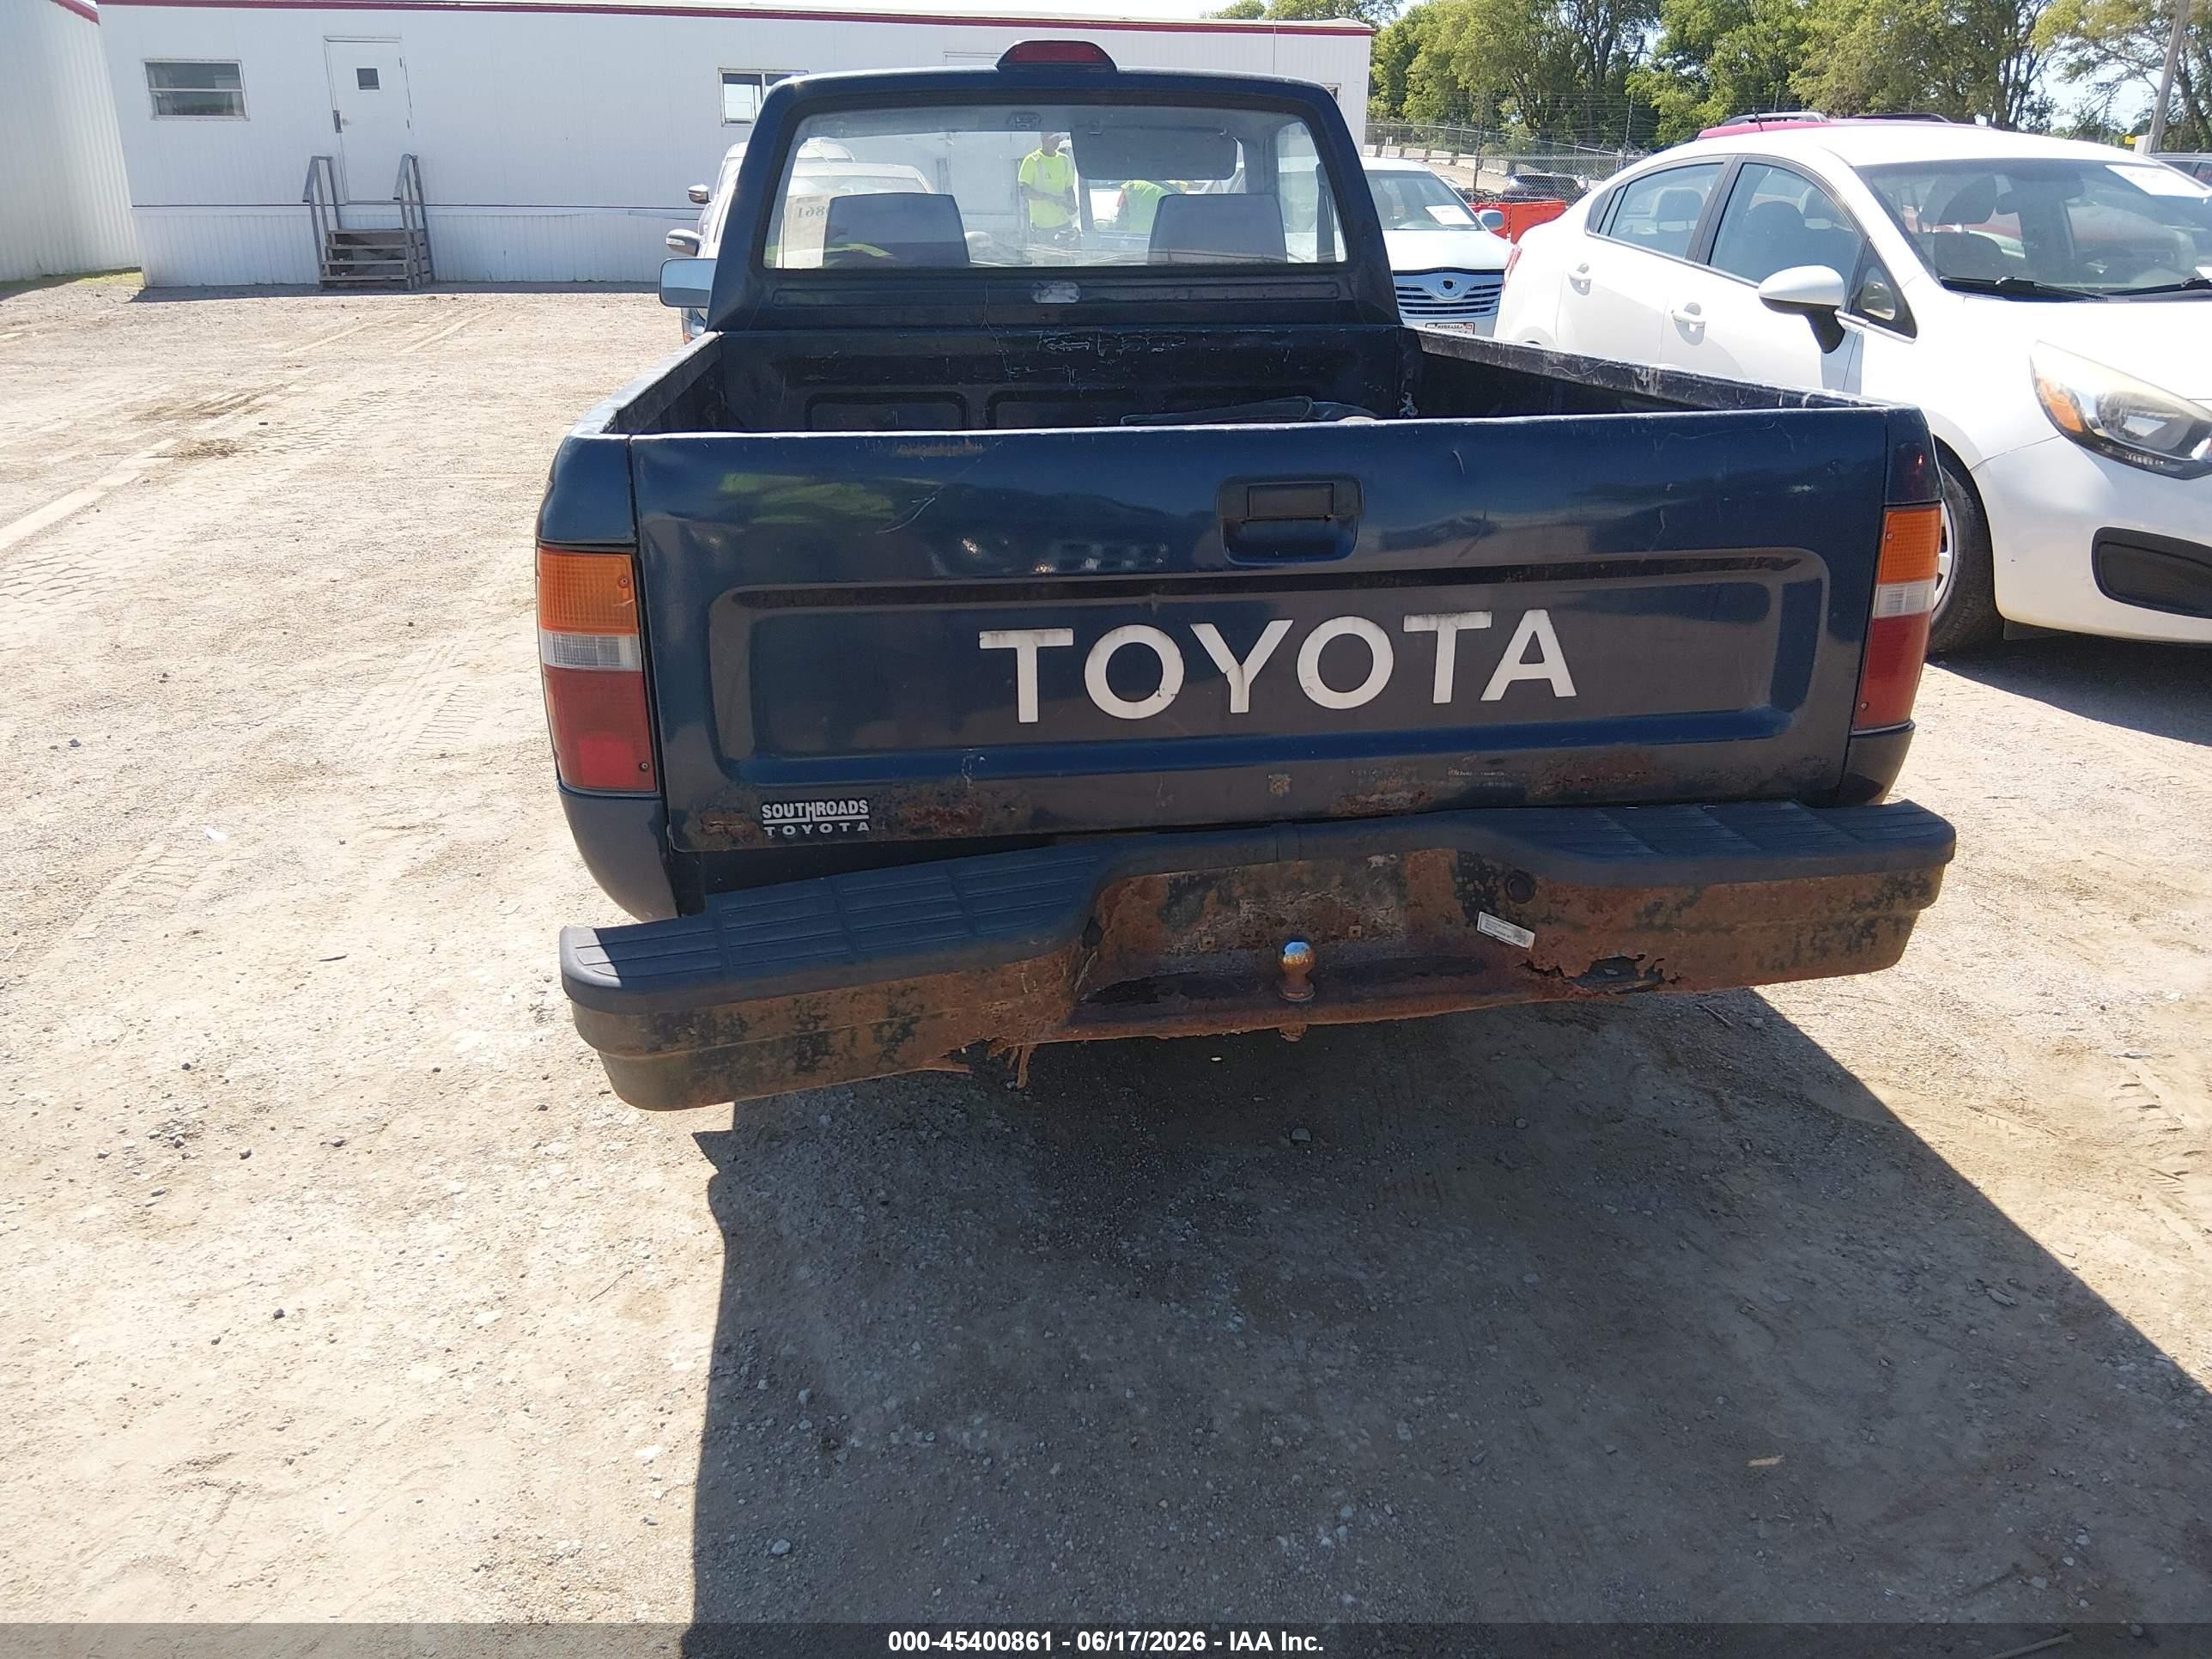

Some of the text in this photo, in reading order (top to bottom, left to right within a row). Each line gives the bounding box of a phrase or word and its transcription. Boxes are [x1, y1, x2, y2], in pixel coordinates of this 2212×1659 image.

[978, 608, 1577, 723] TOYOTA
[762, 799, 869, 822] SOUTHROADS
[763, 822, 869, 837] TOYOTA
